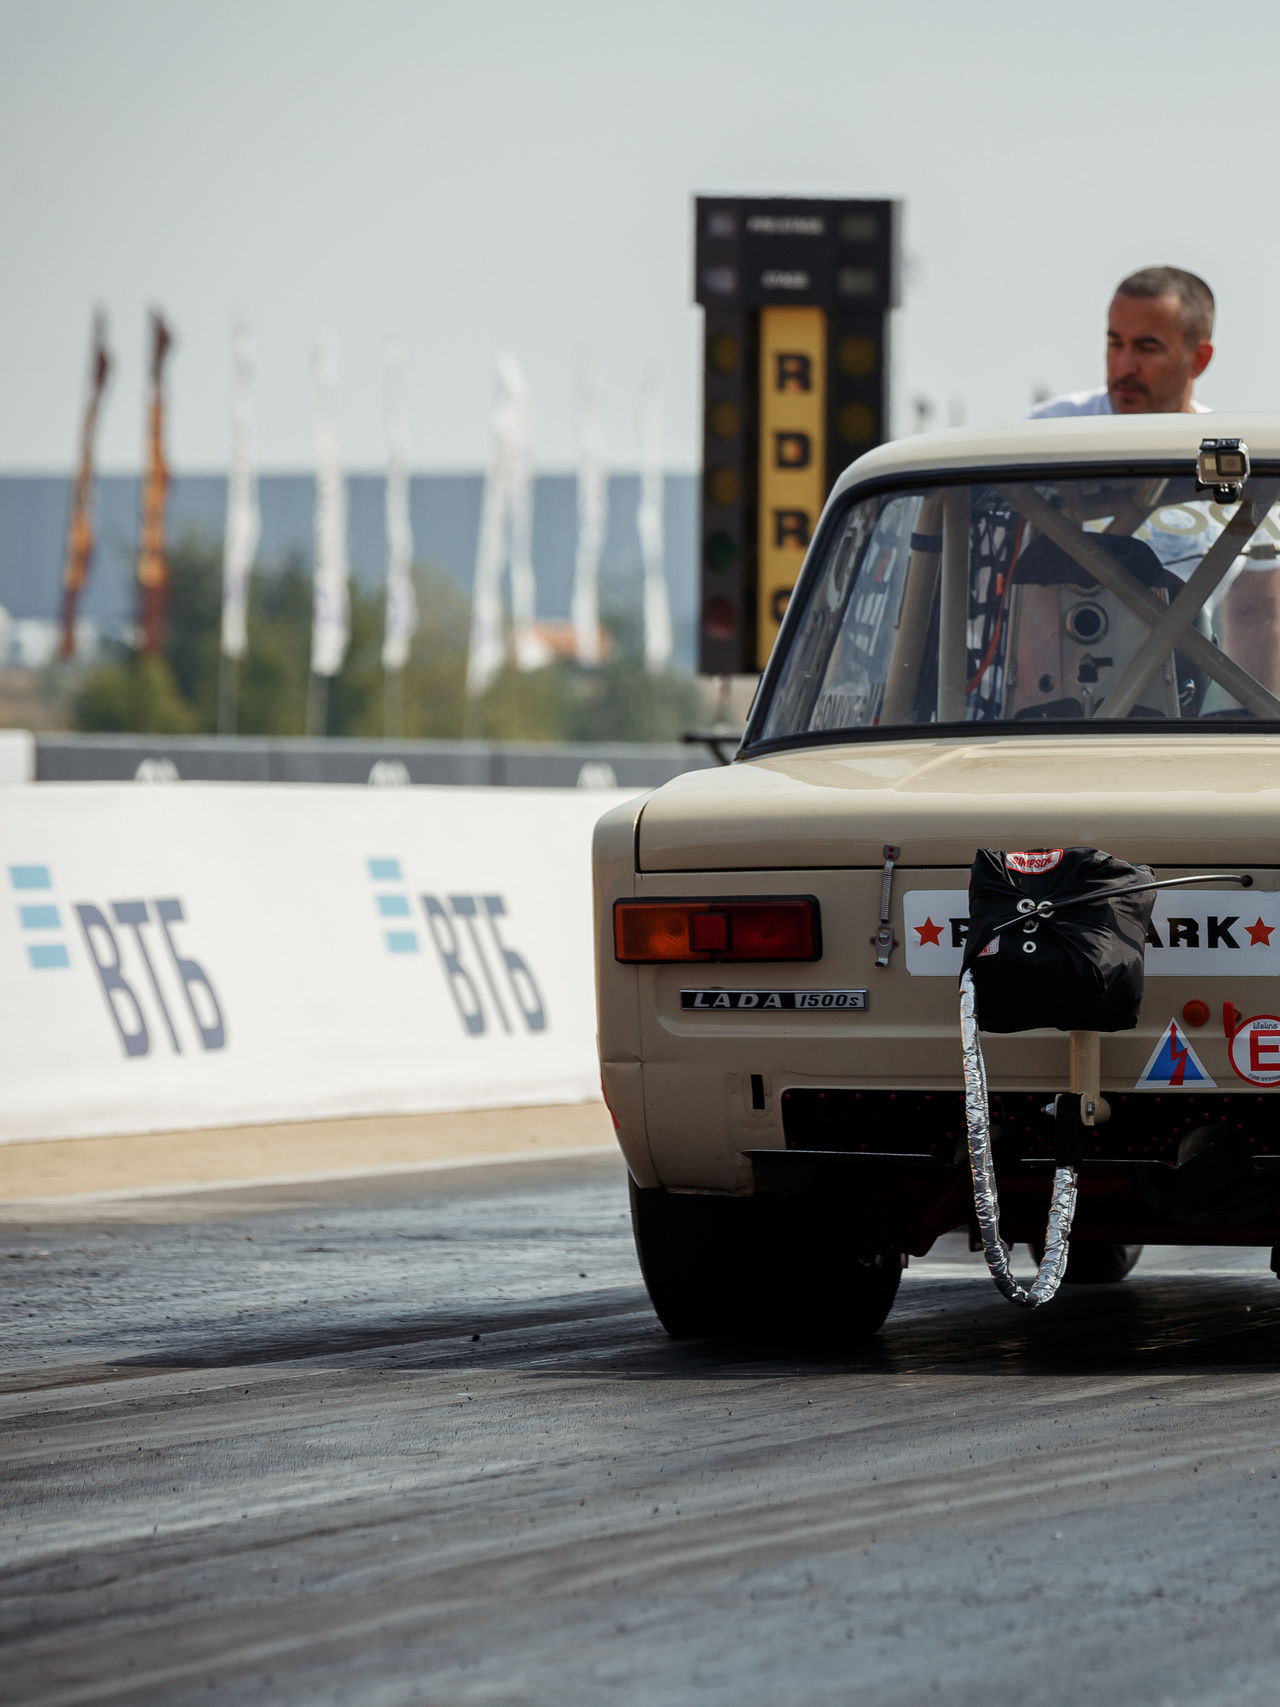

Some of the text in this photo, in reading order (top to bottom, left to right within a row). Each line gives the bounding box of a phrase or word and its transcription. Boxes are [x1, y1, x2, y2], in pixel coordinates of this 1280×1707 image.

[74, 897, 229, 1058] ВТБ
[420, 892, 548, 1036] ВТБ
[693, 992, 783, 1008] LADA
